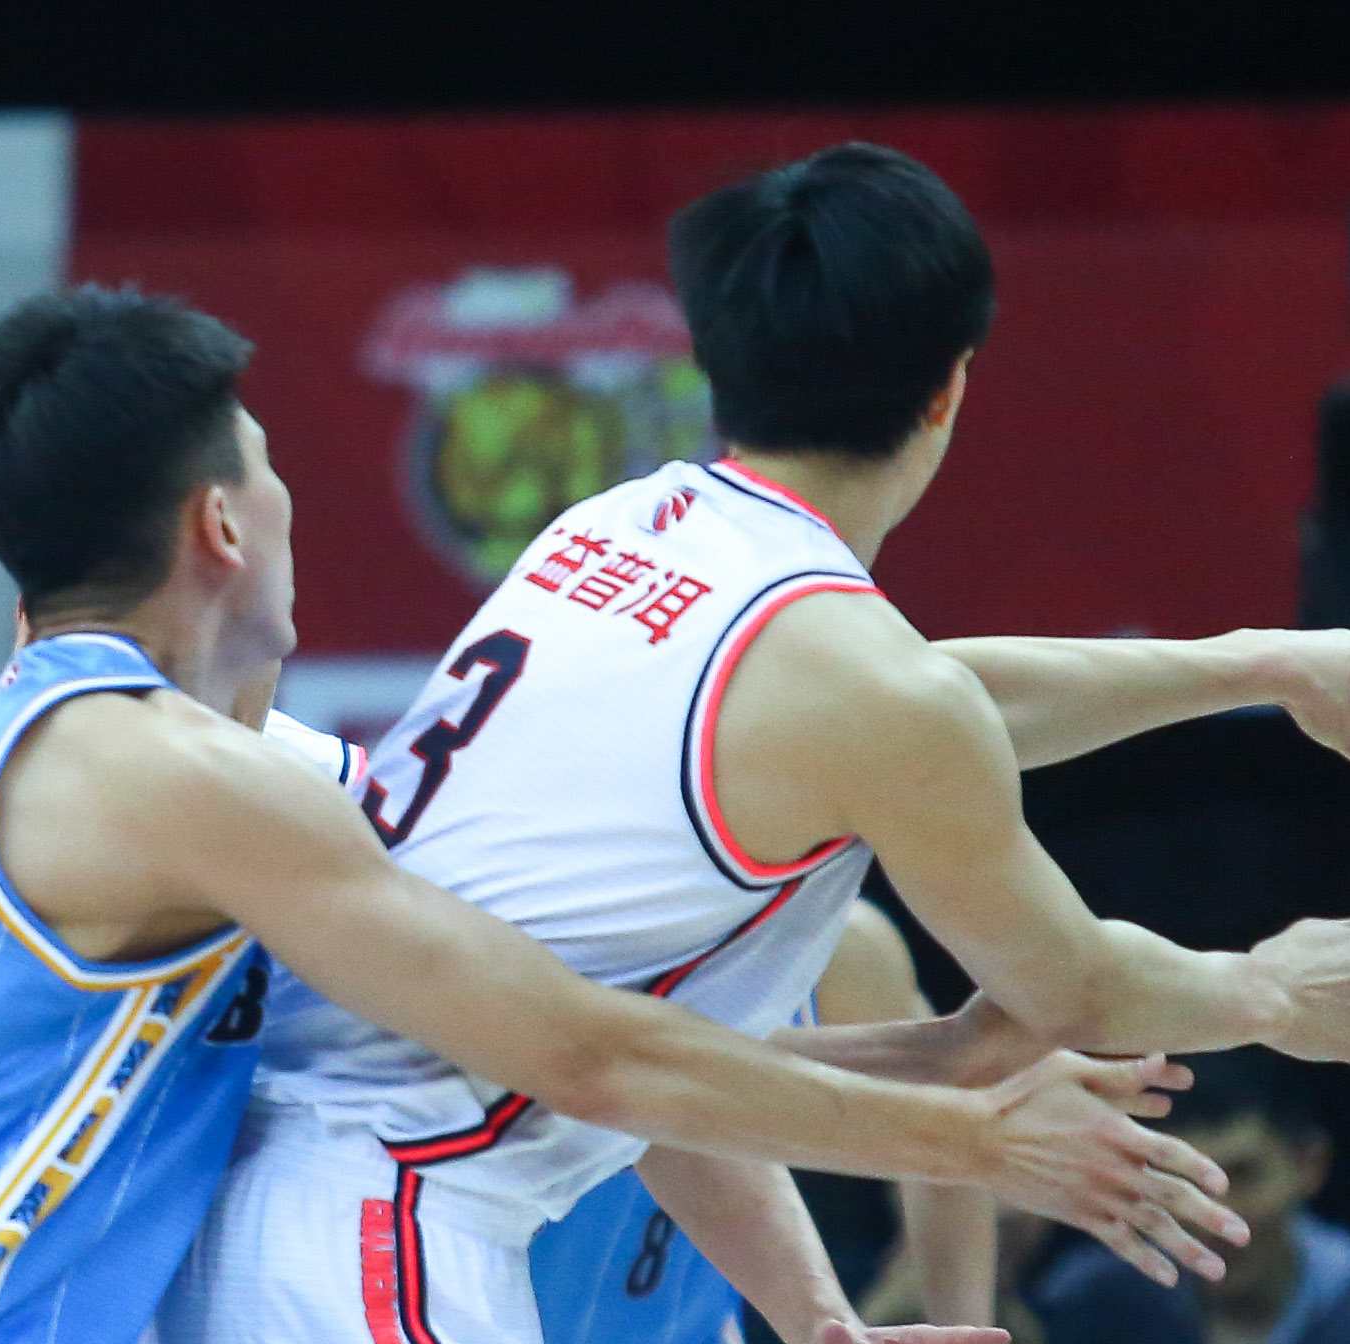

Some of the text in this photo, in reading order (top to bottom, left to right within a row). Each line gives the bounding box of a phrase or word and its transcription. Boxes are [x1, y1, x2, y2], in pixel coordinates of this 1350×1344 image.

[517, 527, 712, 645] 益普洱
[360, 629, 532, 850] 3
